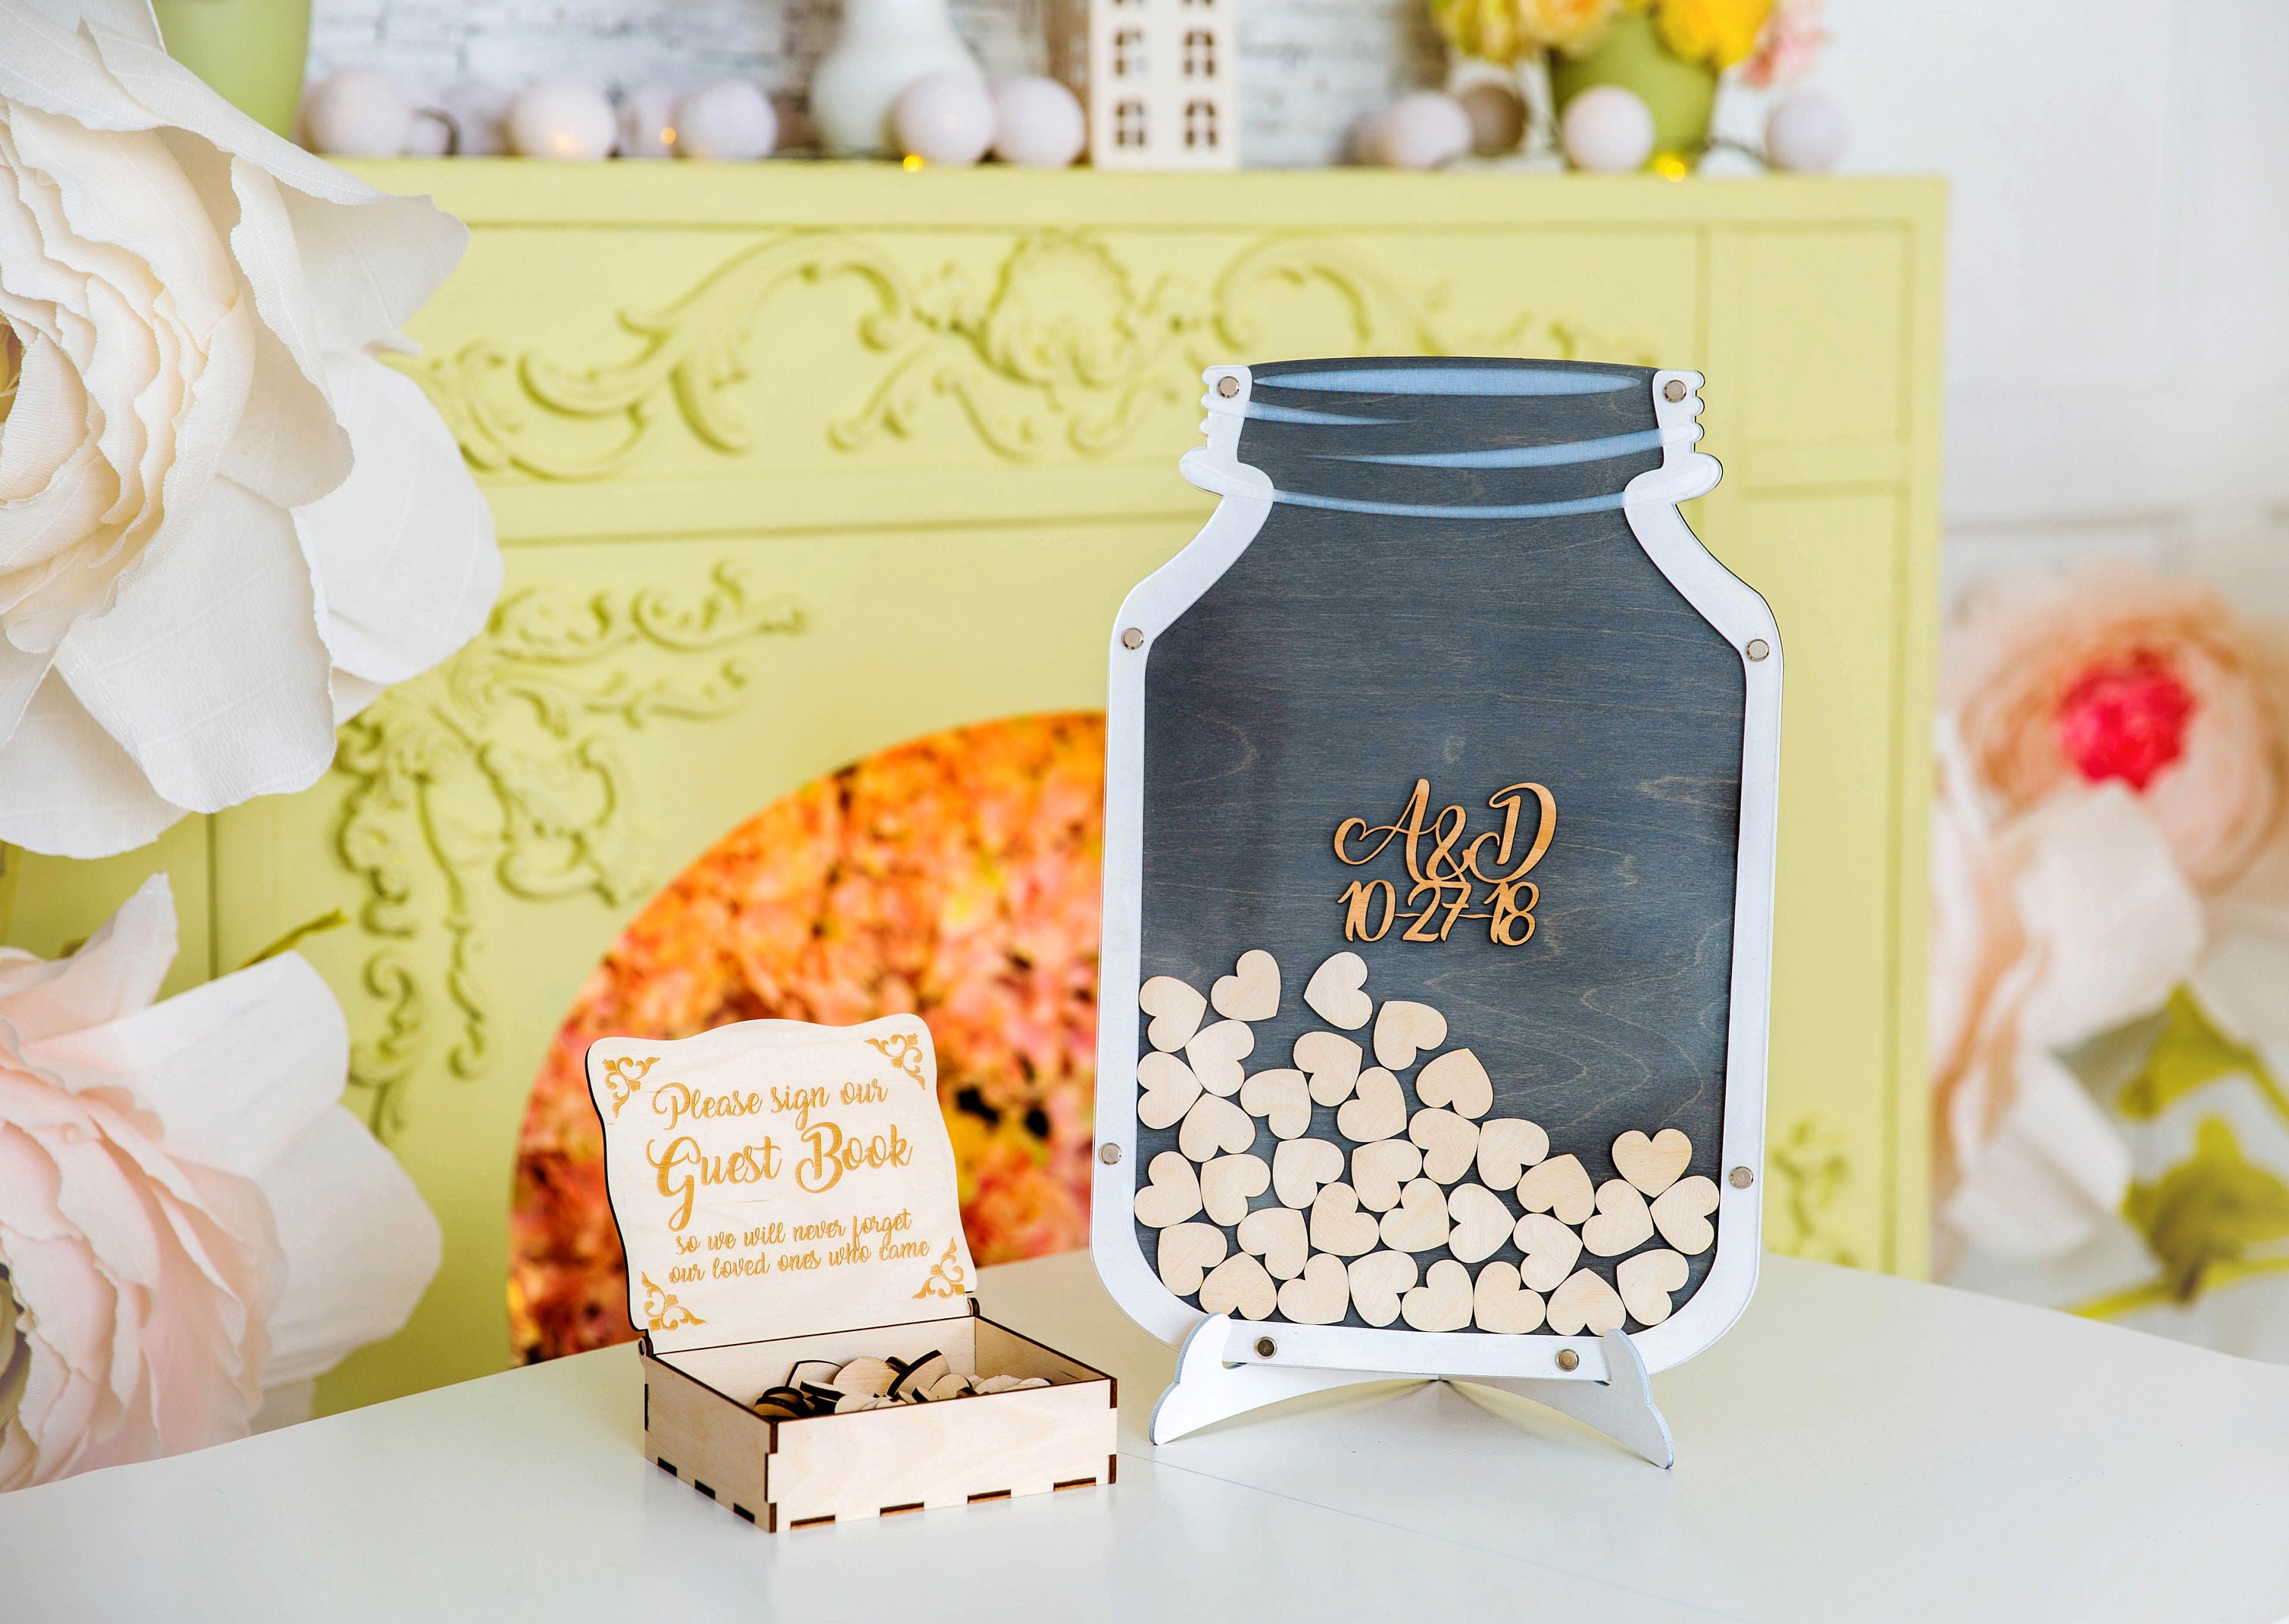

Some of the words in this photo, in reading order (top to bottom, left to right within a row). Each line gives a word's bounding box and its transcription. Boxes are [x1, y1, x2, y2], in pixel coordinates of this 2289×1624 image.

[1334, 778, 1557, 883] A&D
[1336, 878, 1540, 947] 10-27-18
[652, 1083, 762, 1130] Please
[771, 1084, 829, 1131] sign
[840, 1079, 888, 1106] our
[645, 1136, 782, 1232] Guest
[794, 1121, 913, 1194] Book
[668, 1266, 705, 1284] our
[713, 1253, 770, 1279] loved
[777, 1250, 821, 1271] ones
[829, 1243, 871, 1267] who
[879, 1240, 930, 1260] came
[676, 1235, 700, 1256] so
[708, 1230, 736, 1250] we
[744, 1221, 786, 1246] will
[793, 1216, 846, 1242] never
[852, 1208, 912, 1250] forget
